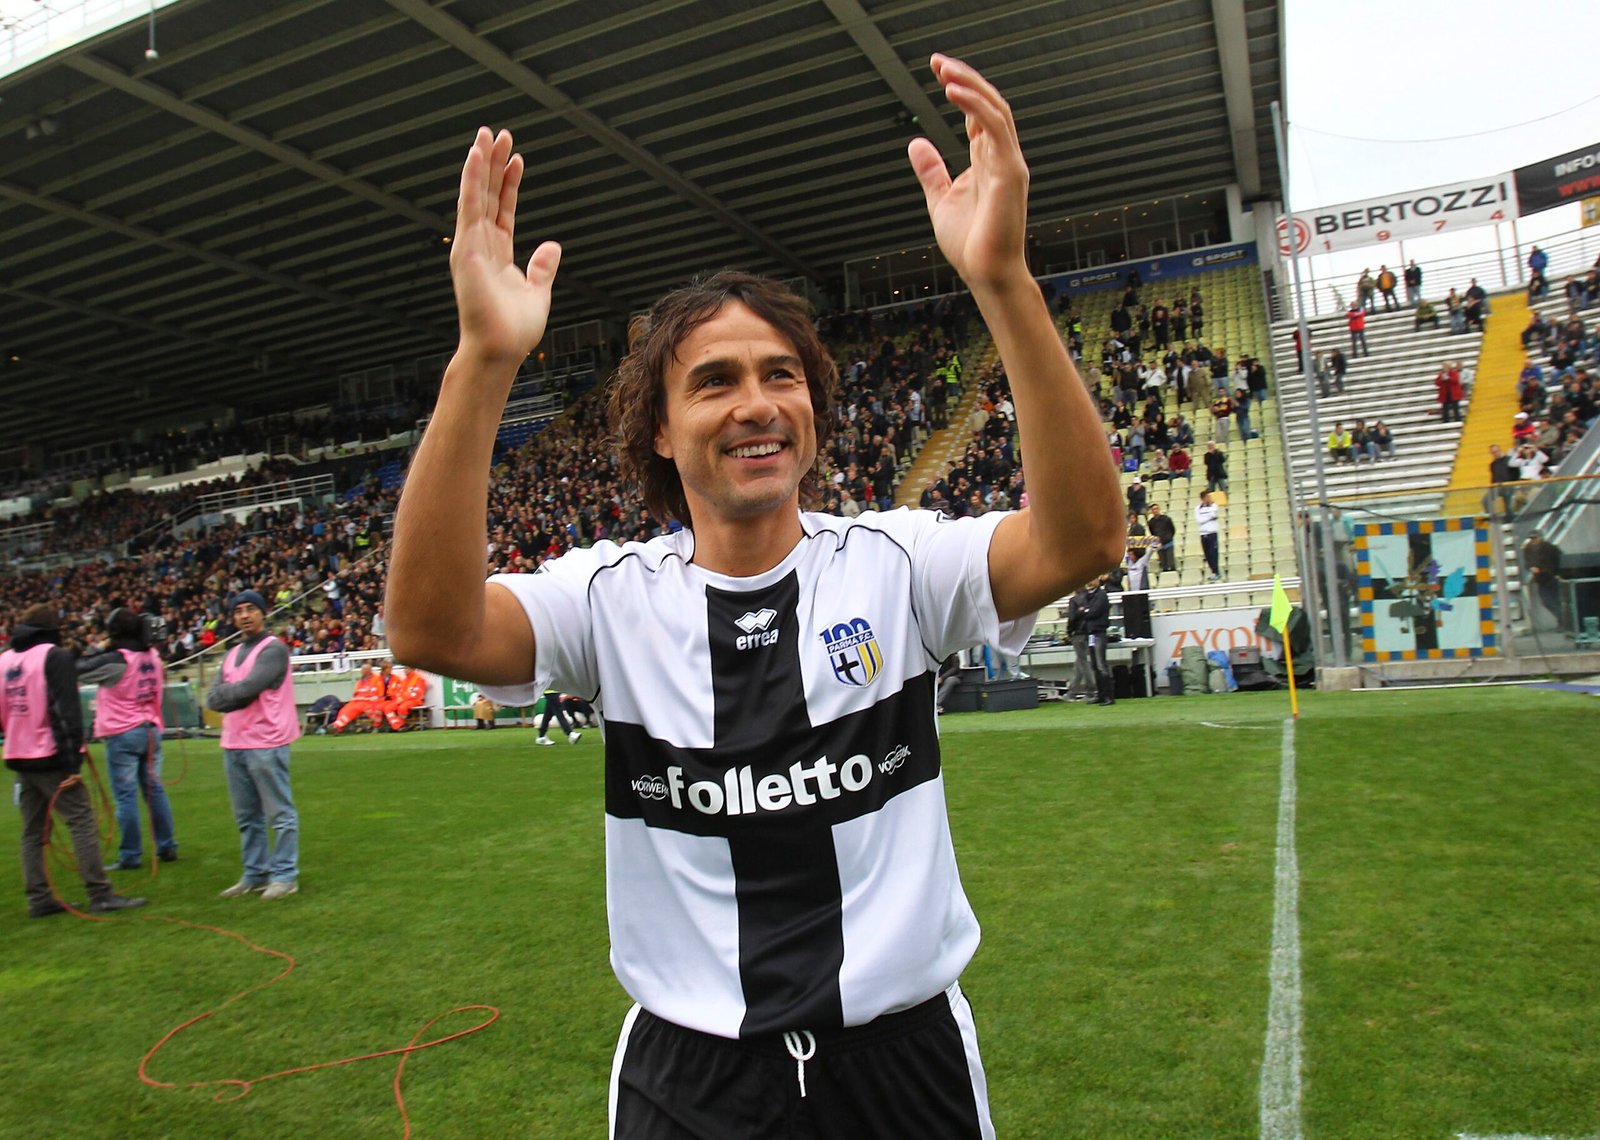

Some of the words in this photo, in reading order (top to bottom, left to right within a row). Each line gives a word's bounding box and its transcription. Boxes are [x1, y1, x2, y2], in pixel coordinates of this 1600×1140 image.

[1554, 151, 1600, 177] INFO
[1314, 181, 1508, 235] BERTOZZI
[828, 636, 860, 654] PARMA
[667, 753, 873, 816] folletto
